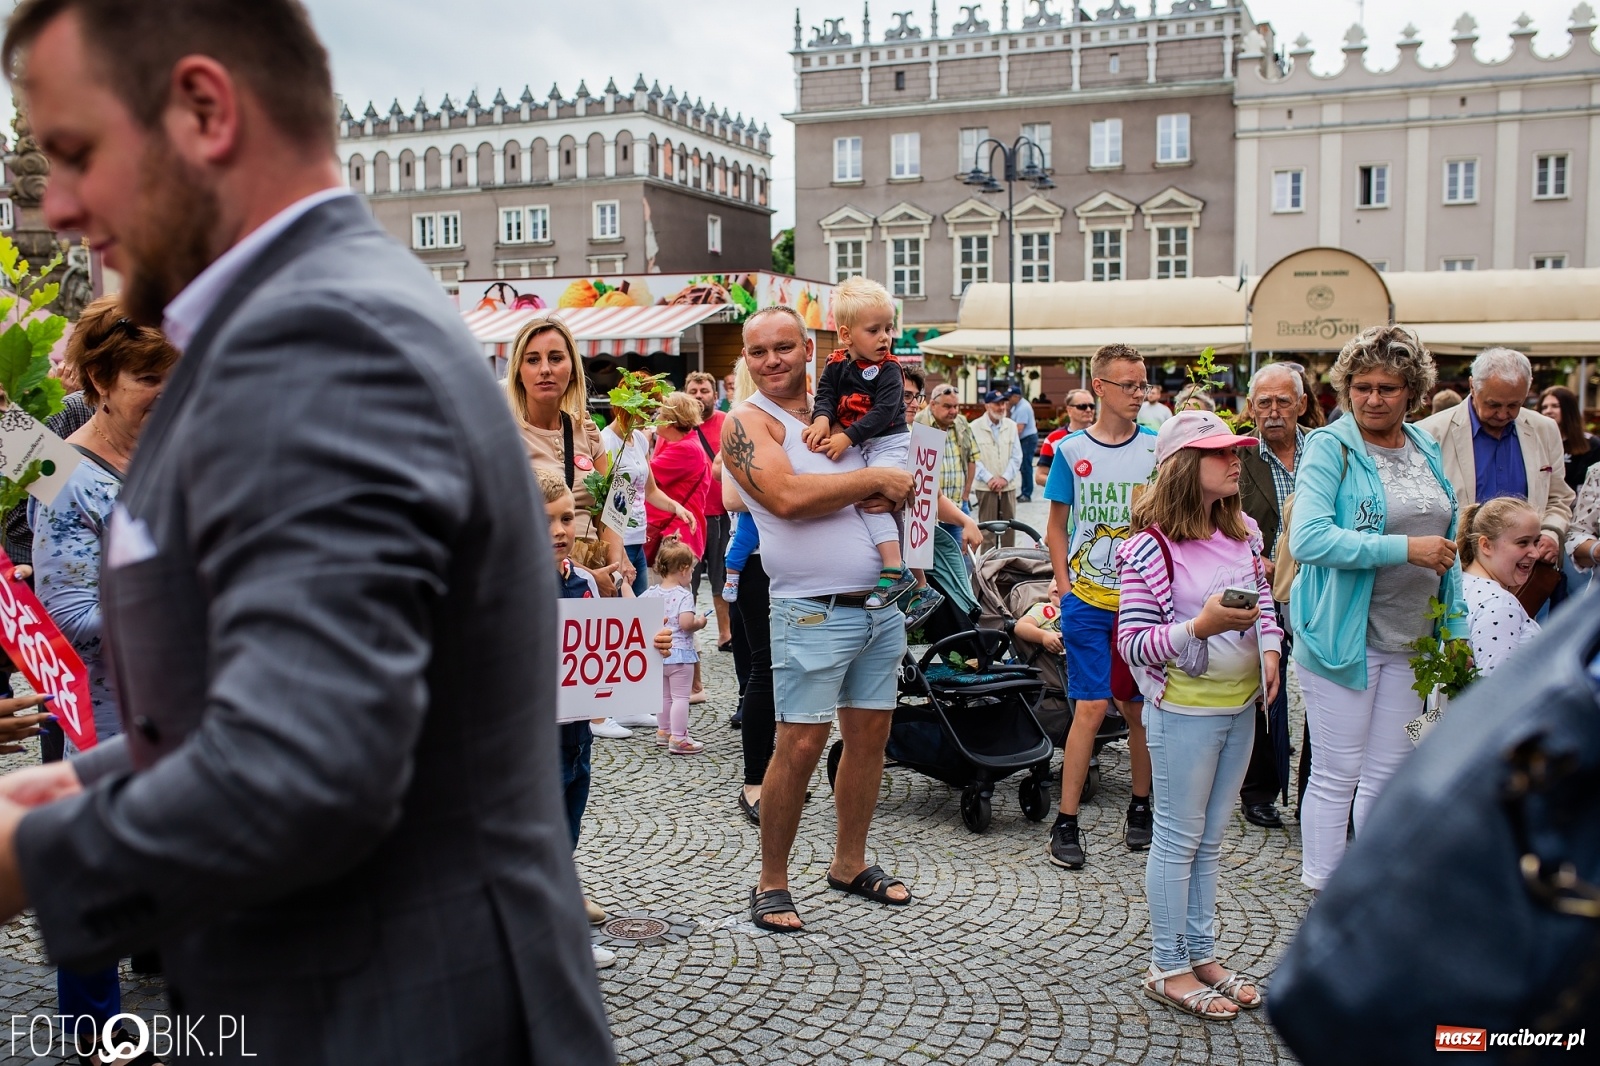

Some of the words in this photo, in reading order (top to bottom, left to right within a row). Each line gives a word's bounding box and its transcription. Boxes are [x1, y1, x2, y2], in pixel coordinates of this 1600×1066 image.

[918, 448, 937, 547] DUDA
[1080, 506, 1131, 523] MONDA
[562, 618, 647, 653] DUDA
[561, 650, 648, 687] 2020
